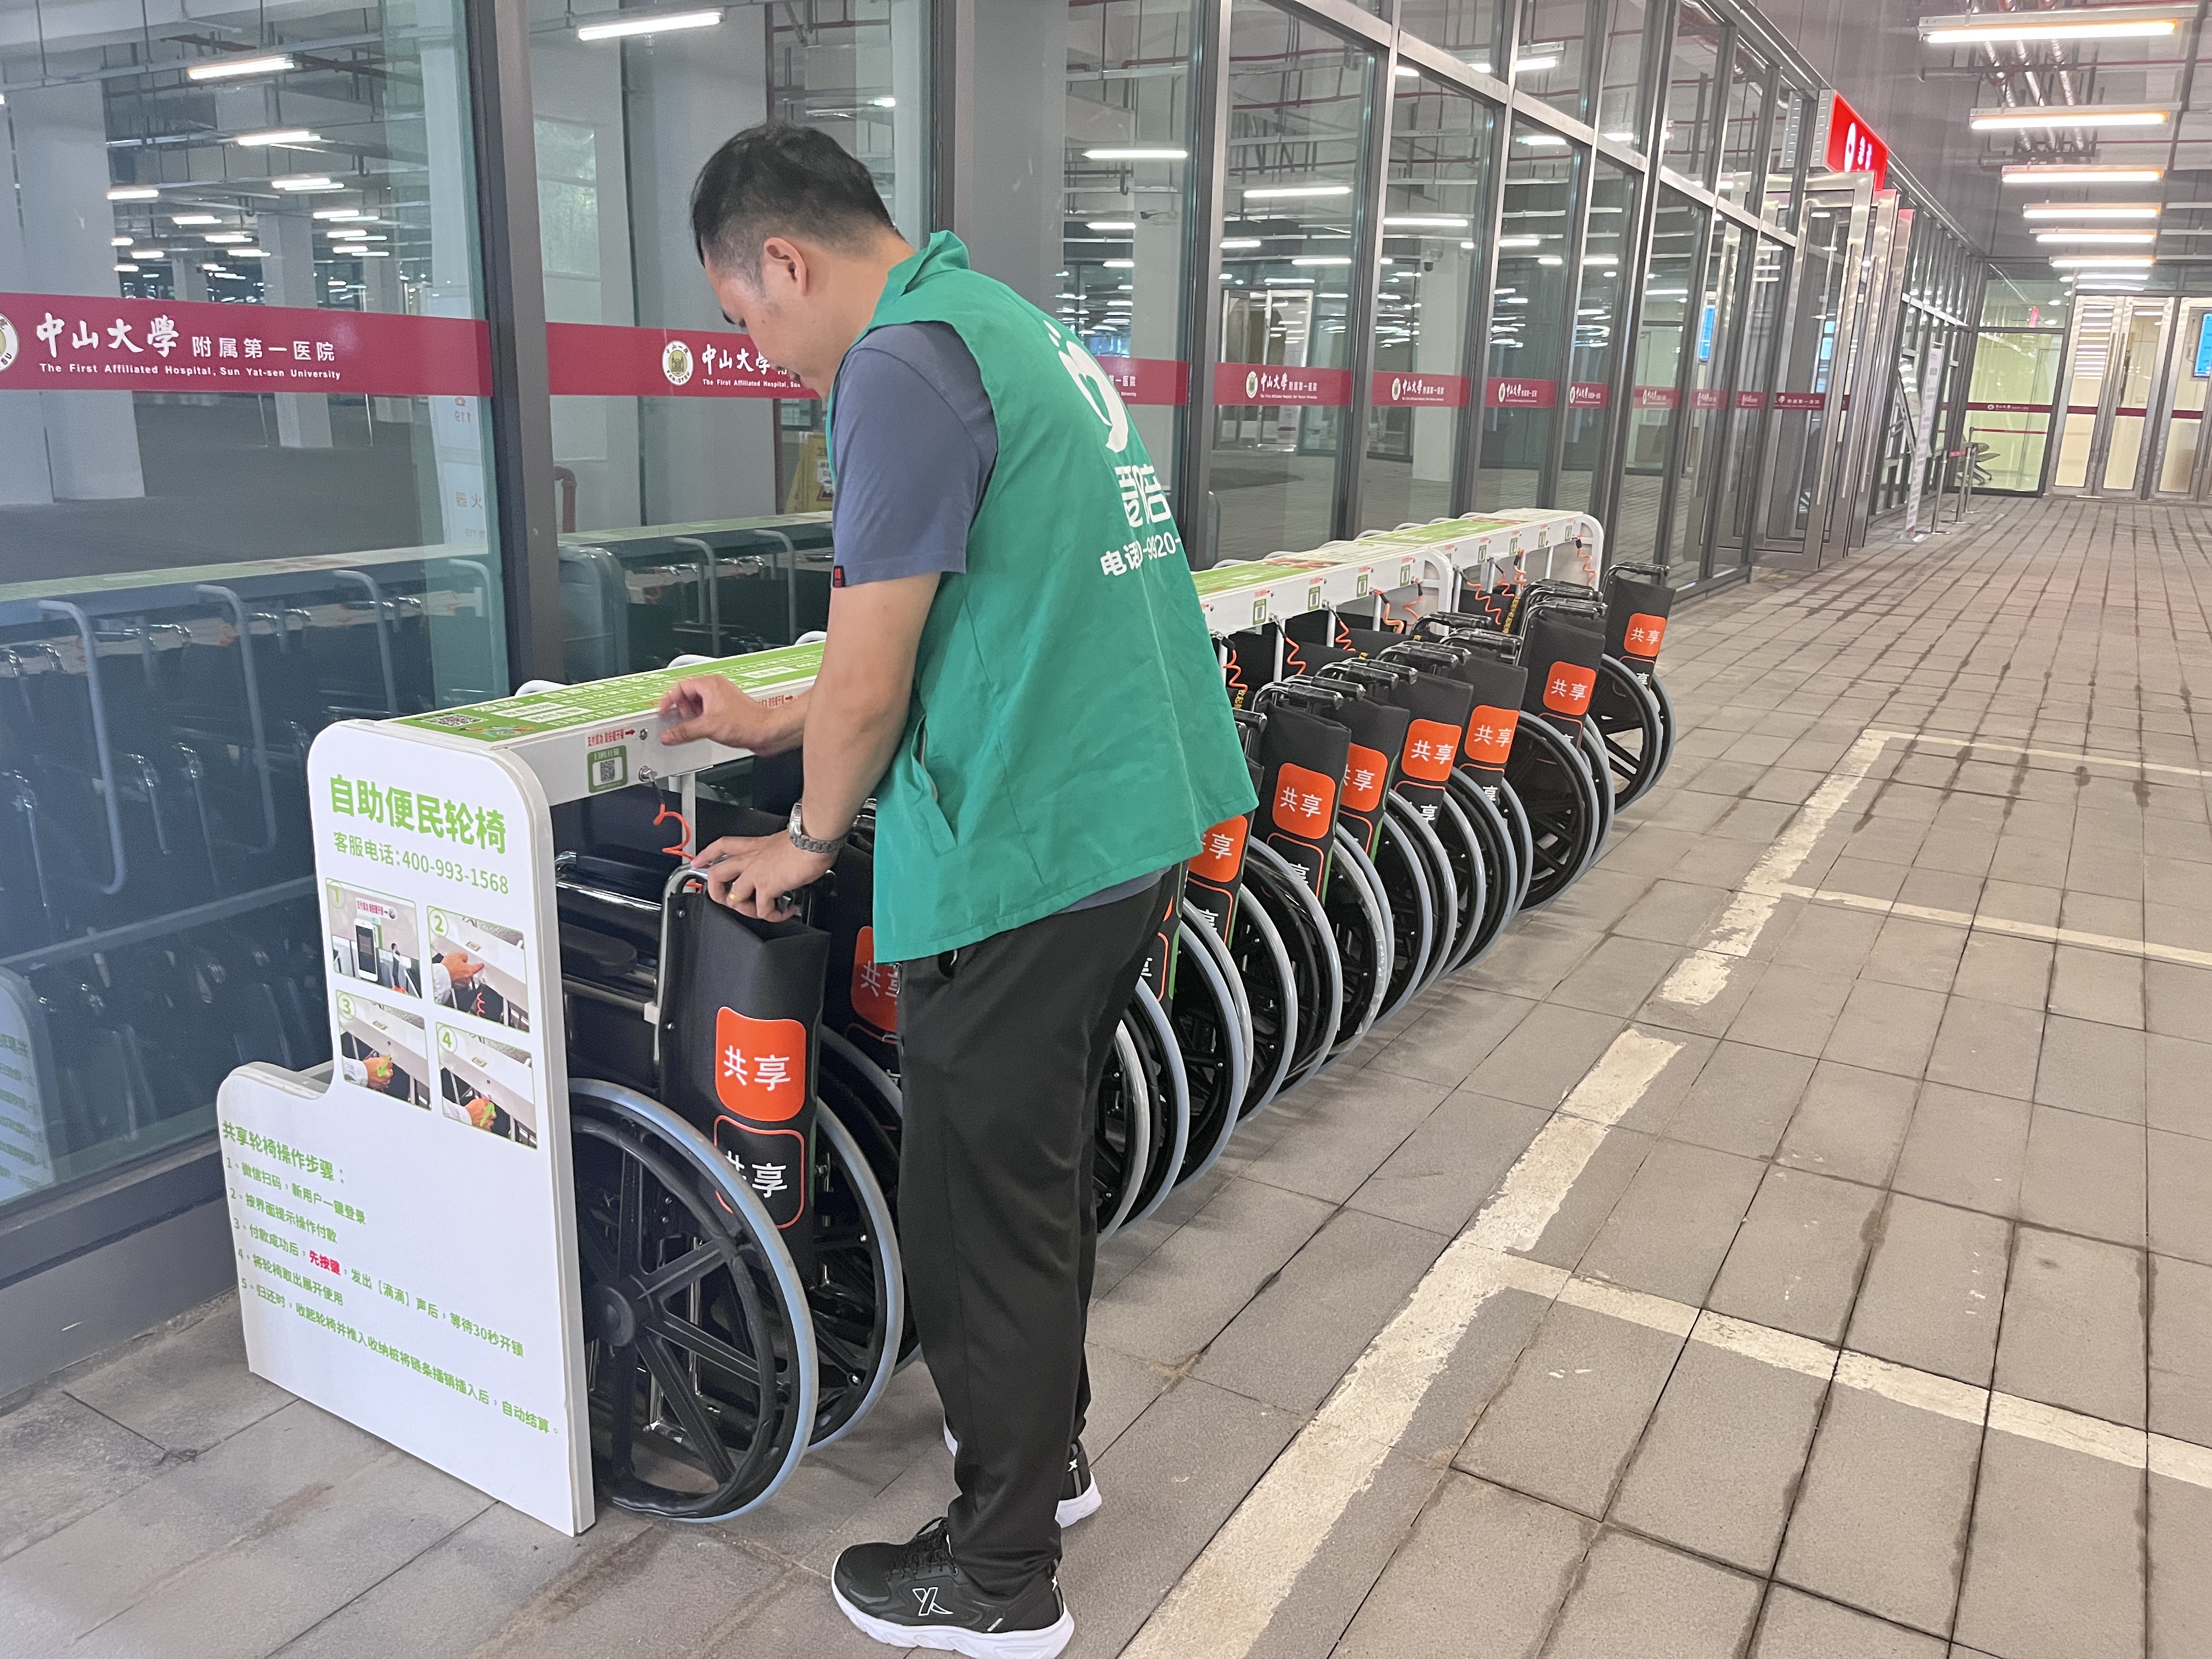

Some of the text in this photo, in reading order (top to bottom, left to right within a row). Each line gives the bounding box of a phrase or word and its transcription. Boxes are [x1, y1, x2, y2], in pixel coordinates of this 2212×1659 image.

[192, 336, 335, 361] 附属第一医院
[40, 363, 341, 380] The First Affiliated Hospital, Sun Yat-sen University
[1629, 627, 1661, 645] 共享
[1550, 678, 1588, 701] 共享
[1474, 725, 1513, 747] 共享
[1410, 740, 1454, 765] 共享
[330, 774, 506, 855] 自助便民轮椅
[1280, 786, 1323, 818] 共享
[1201, 833, 1234, 859] 享
[723, 1045, 791, 1091] 共享
